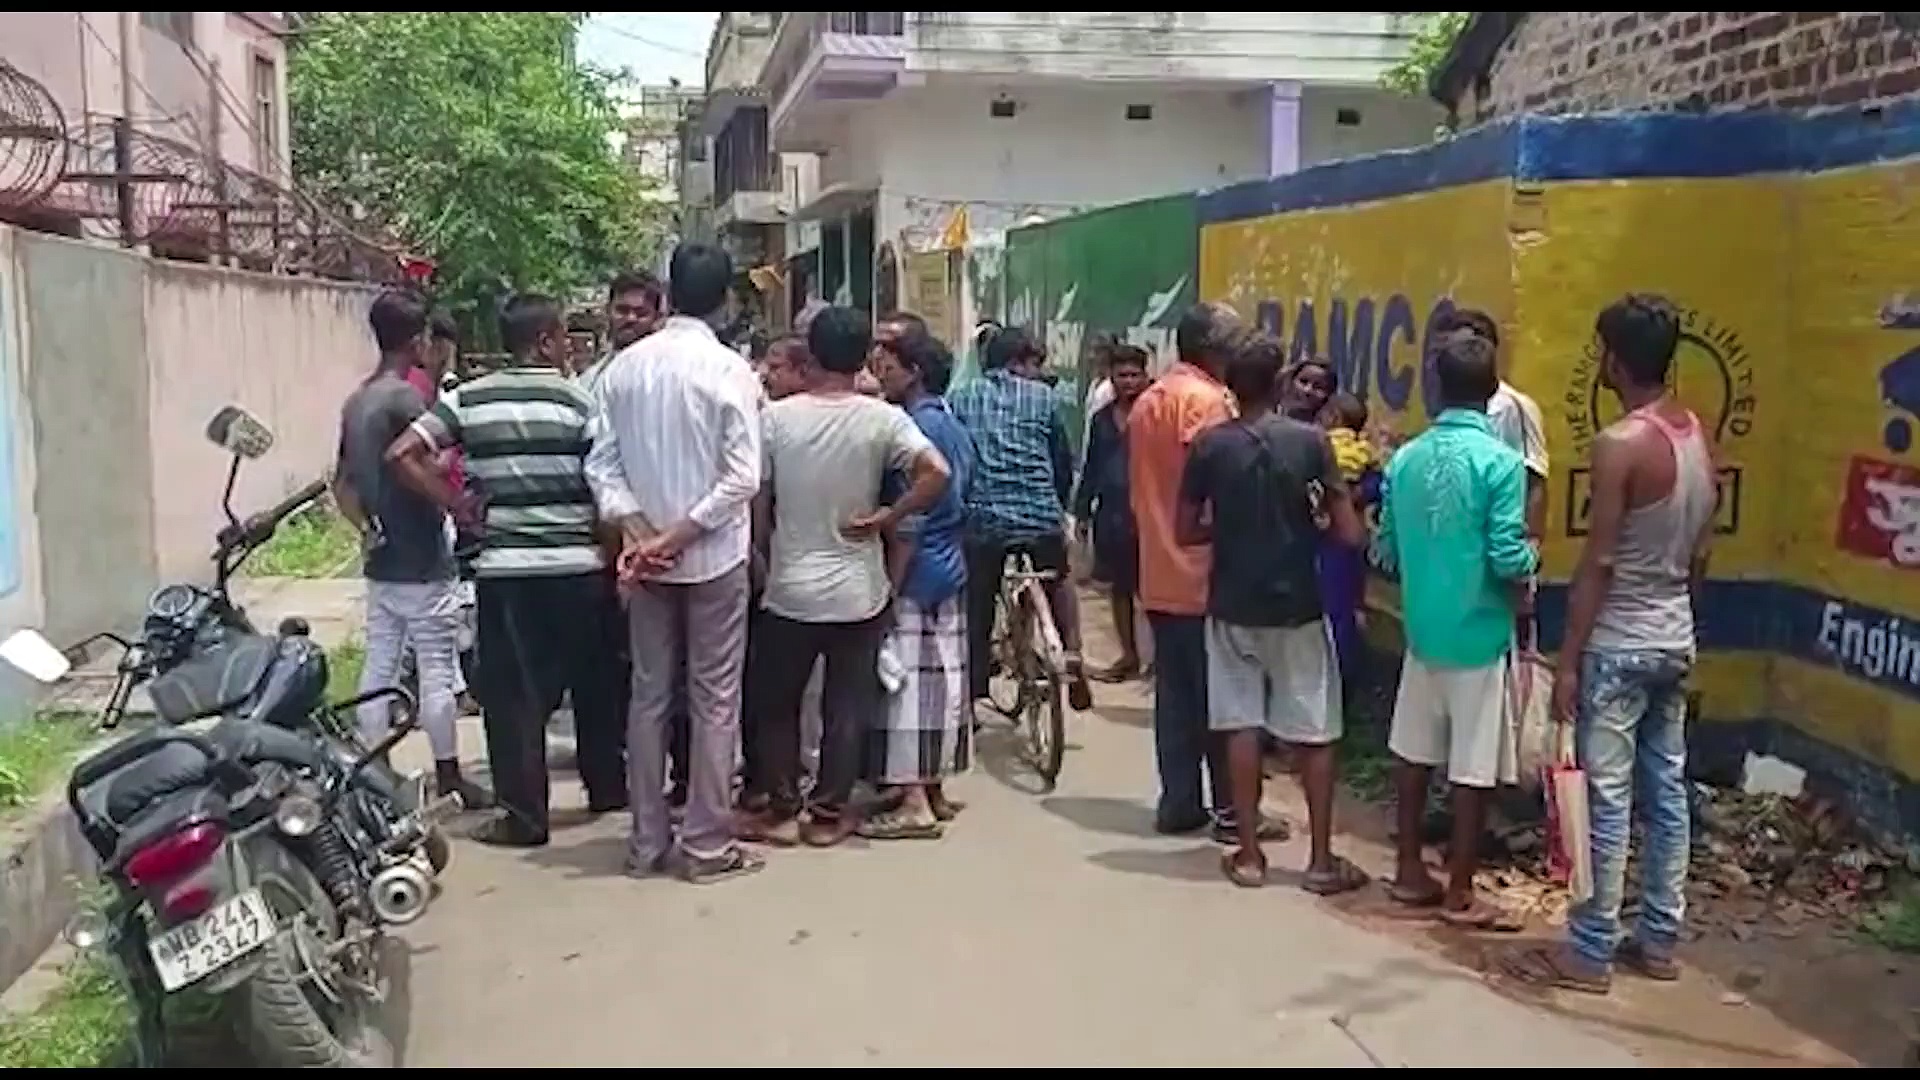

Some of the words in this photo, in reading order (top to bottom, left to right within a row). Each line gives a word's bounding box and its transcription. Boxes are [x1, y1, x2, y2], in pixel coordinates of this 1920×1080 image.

[1565, 335, 1600, 405] RAMC
[1704, 318, 1757, 437] LIMITED
[200, 917, 259, 967] 2347
